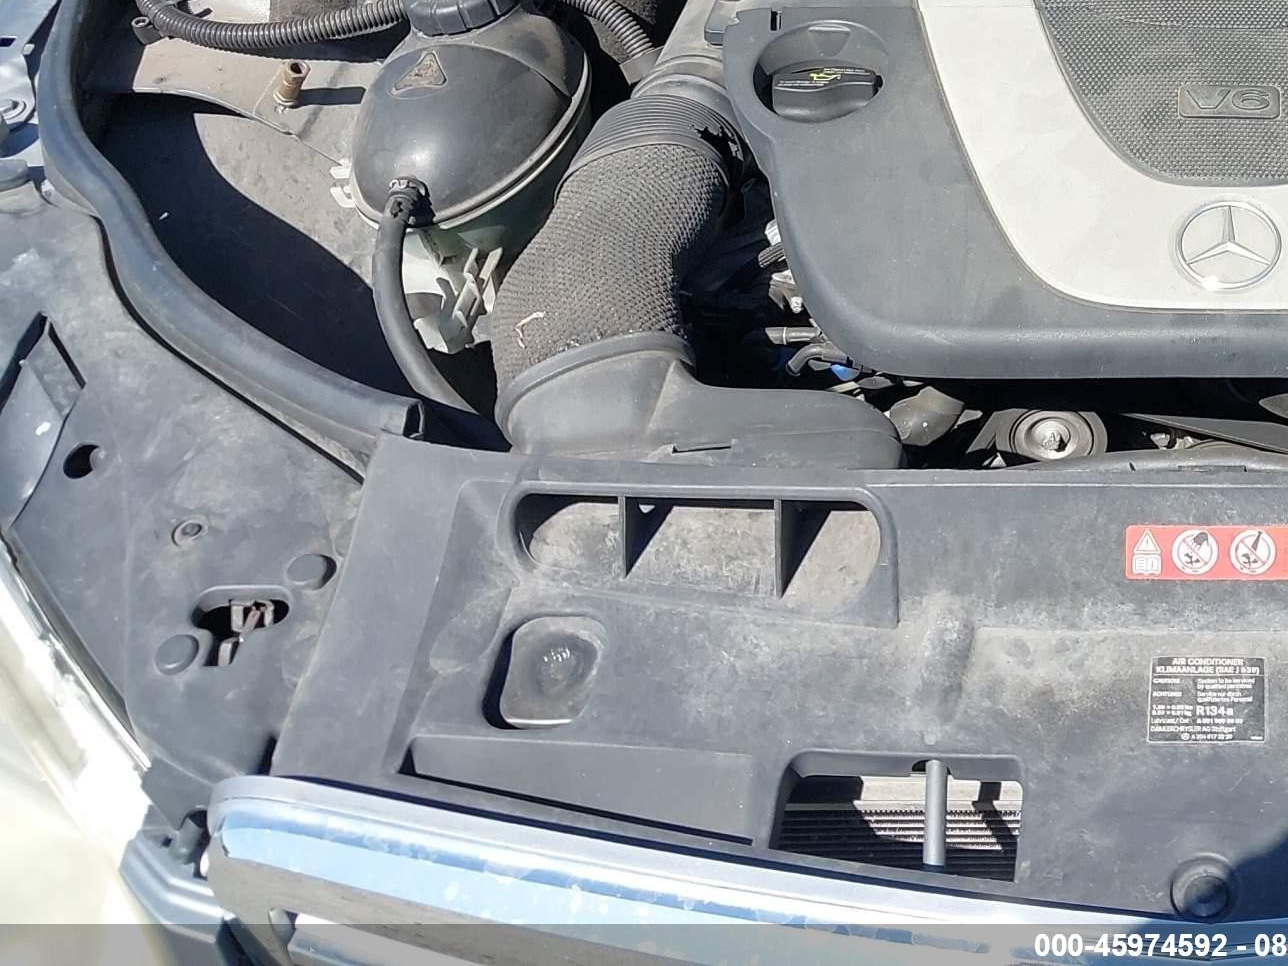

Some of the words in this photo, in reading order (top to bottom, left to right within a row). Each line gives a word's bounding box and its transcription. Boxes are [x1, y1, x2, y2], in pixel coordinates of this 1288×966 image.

[1186, 88, 1270, 111] V6
[1172, 658, 1187, 666] AIR
[1187, 658, 1244, 666] CONDITIONER
[1156, 666, 1214, 674] KLIMAANLAGE
[1196, 706, 1234, 716] R134a
